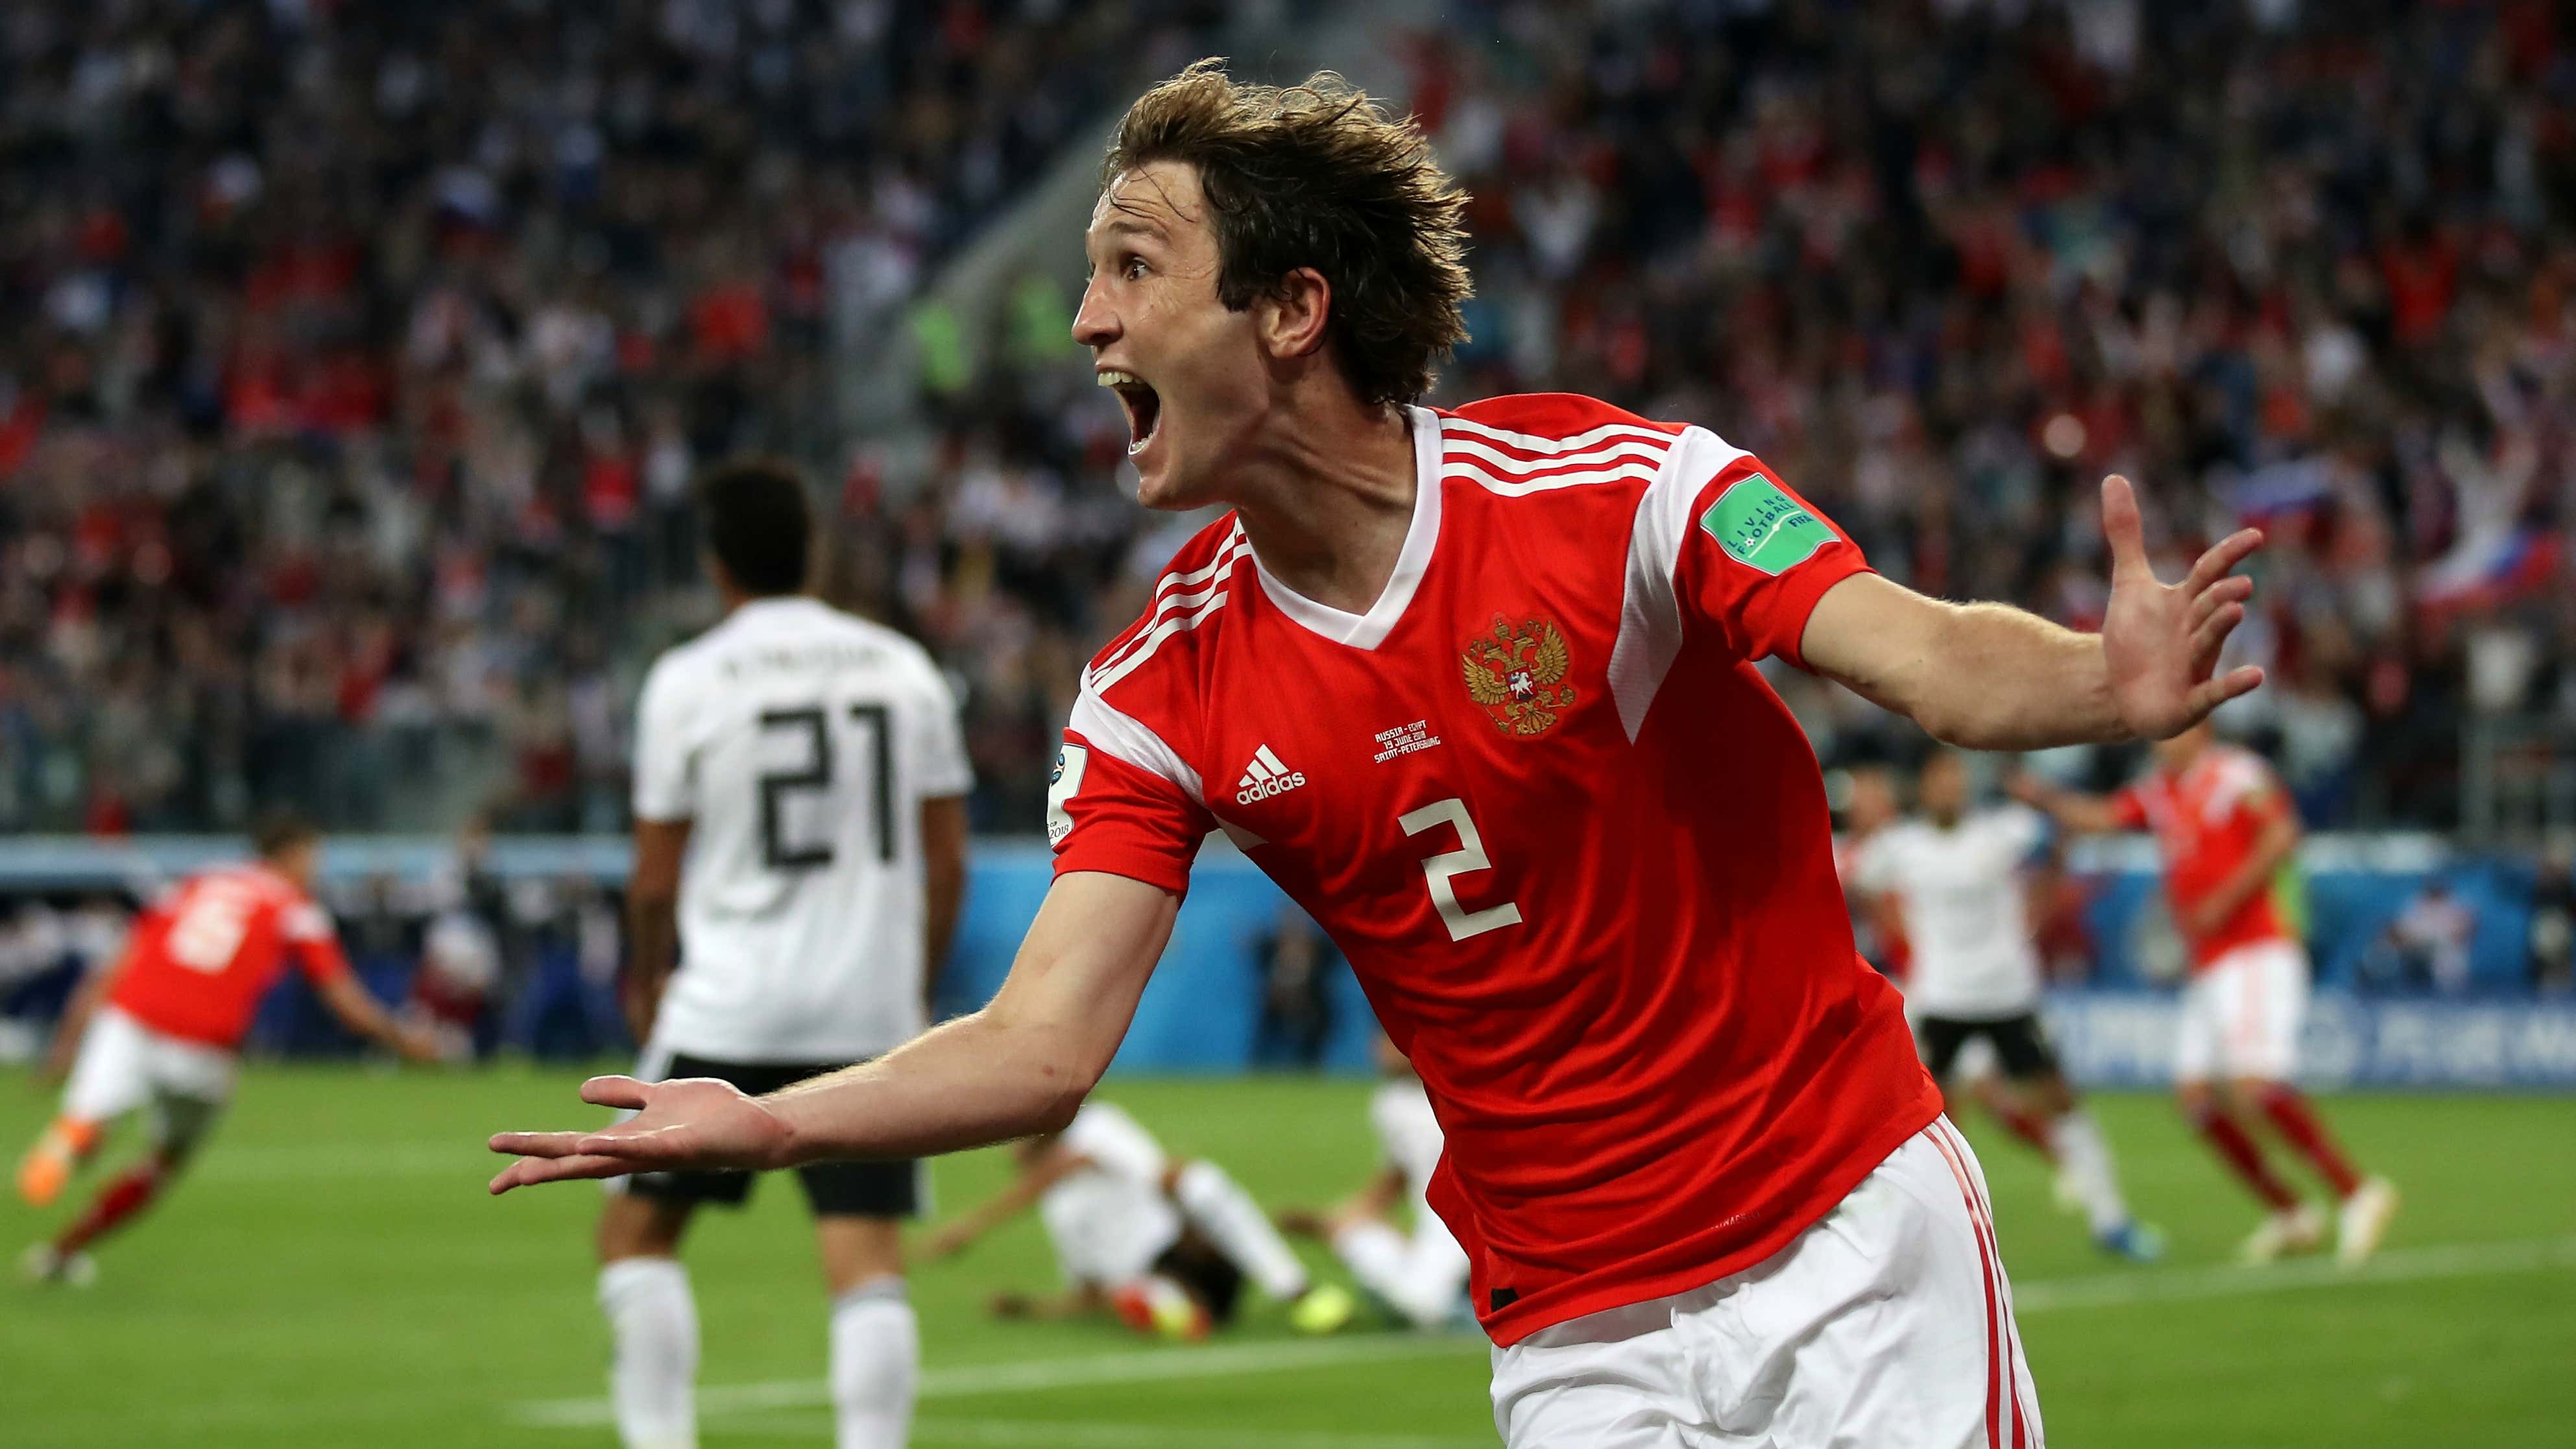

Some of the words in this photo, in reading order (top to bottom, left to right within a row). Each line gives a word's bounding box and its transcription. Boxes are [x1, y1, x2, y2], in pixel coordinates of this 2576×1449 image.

[1727, 495, 1785, 548] LIVING
[1788, 515, 1814, 528] FIFA
[1375, 726, 1404, 743] RUSSIA
[1384, 740, 1393, 749] 19
[1394, 734, 1413, 747] JUNE
[758, 701, 894, 868] 21
[1236, 771, 1306, 805] adidas
[1048, 824, 1069, 839] 2018
[1398, 798, 1523, 942] 2
